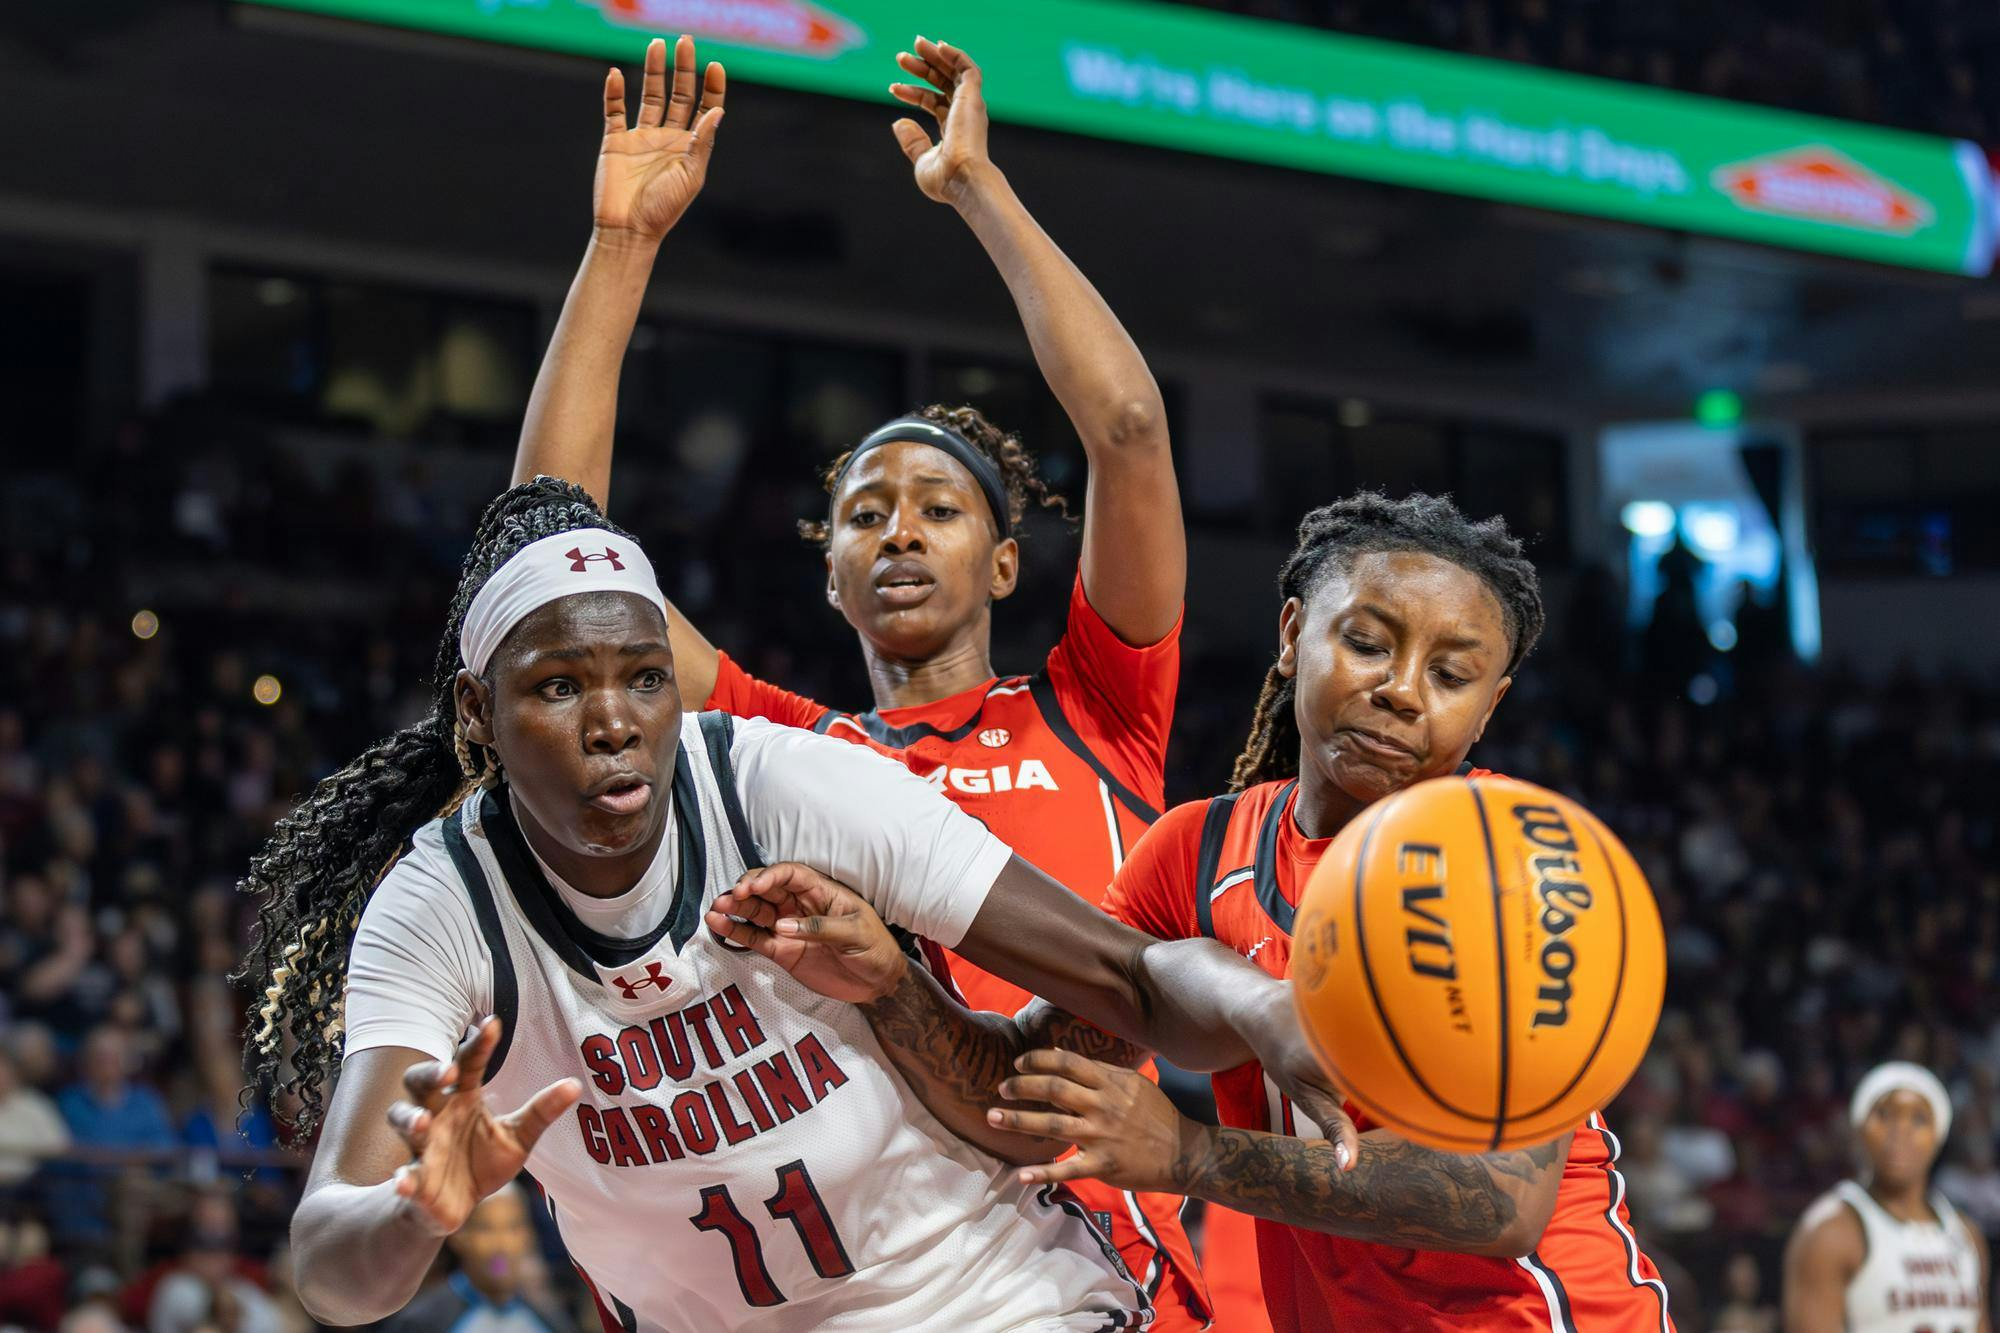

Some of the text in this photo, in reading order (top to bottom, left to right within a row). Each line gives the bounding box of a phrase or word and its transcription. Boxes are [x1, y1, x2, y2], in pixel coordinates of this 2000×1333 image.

[979, 729, 1010, 747] SEC
[1399, 841, 1459, 981] EVO
[1511, 803, 1593, 1029] Wilson
[577, 1032, 849, 1167] CAROLINA
[581, 983, 767, 1096] SOUTH
[689, 1159, 857, 1307] 11
